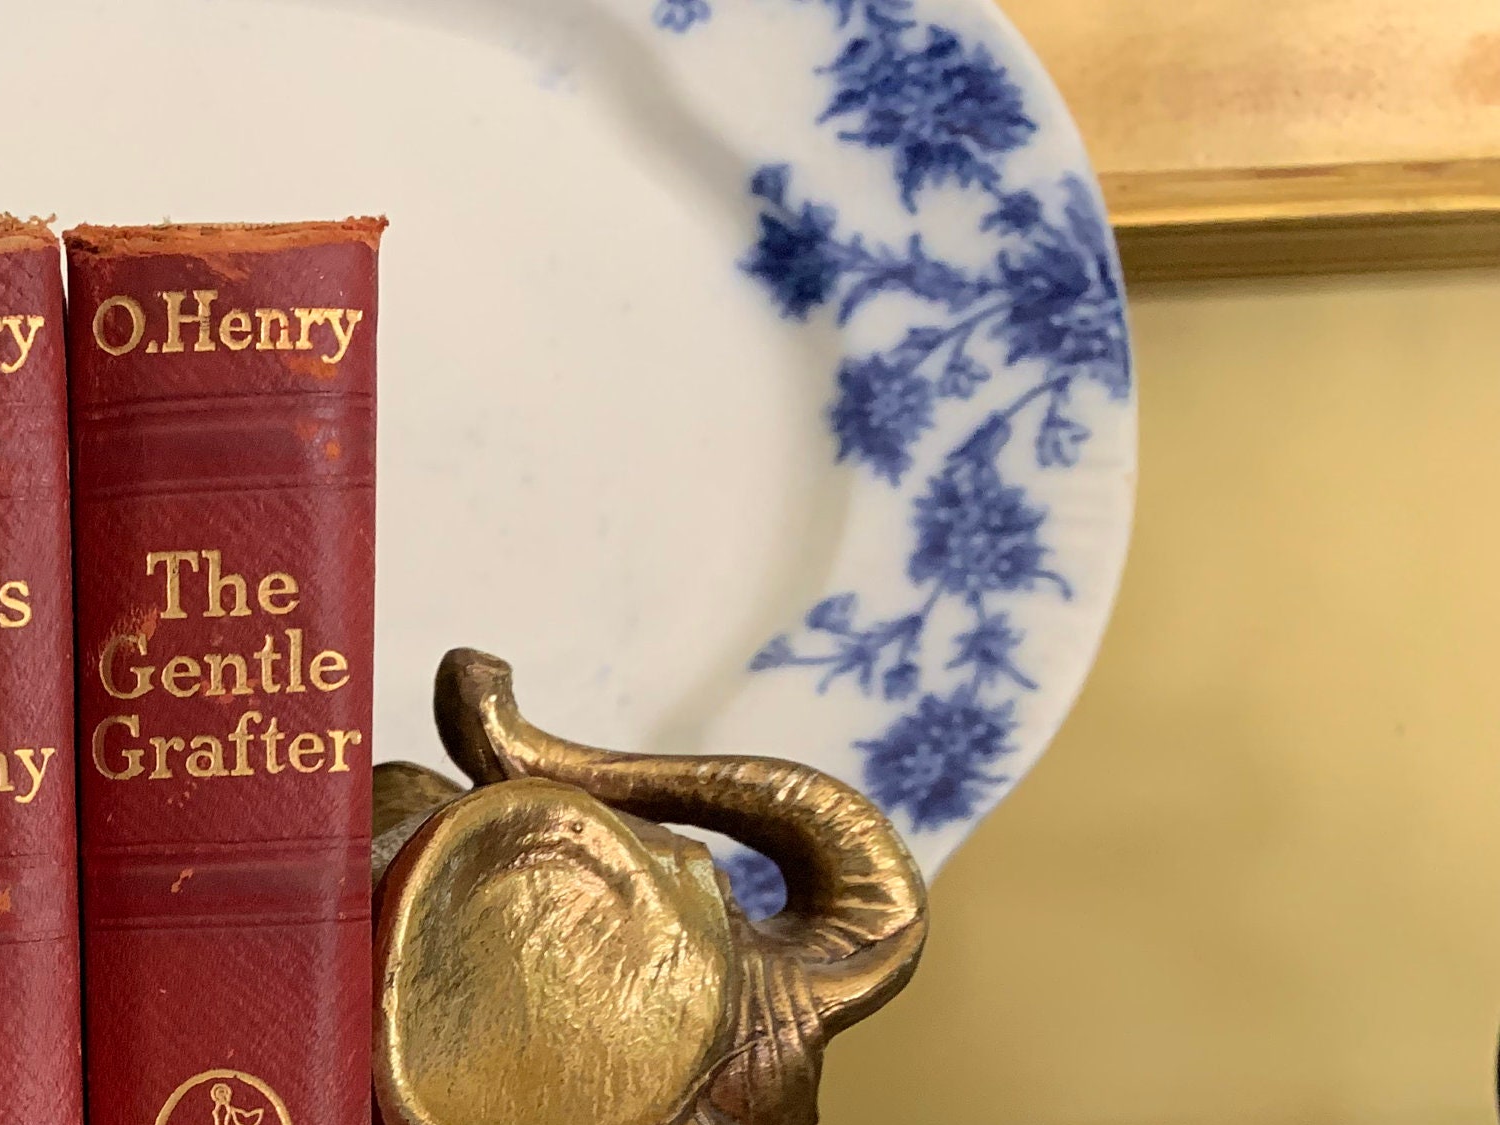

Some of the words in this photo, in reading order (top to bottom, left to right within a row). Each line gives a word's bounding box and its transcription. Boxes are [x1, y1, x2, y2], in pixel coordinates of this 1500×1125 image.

[92, 289, 363, 364] O.Henry
[146, 549, 301, 621] The
[99, 628, 351, 700] Gentle
[92, 710, 363, 782] Grafter
